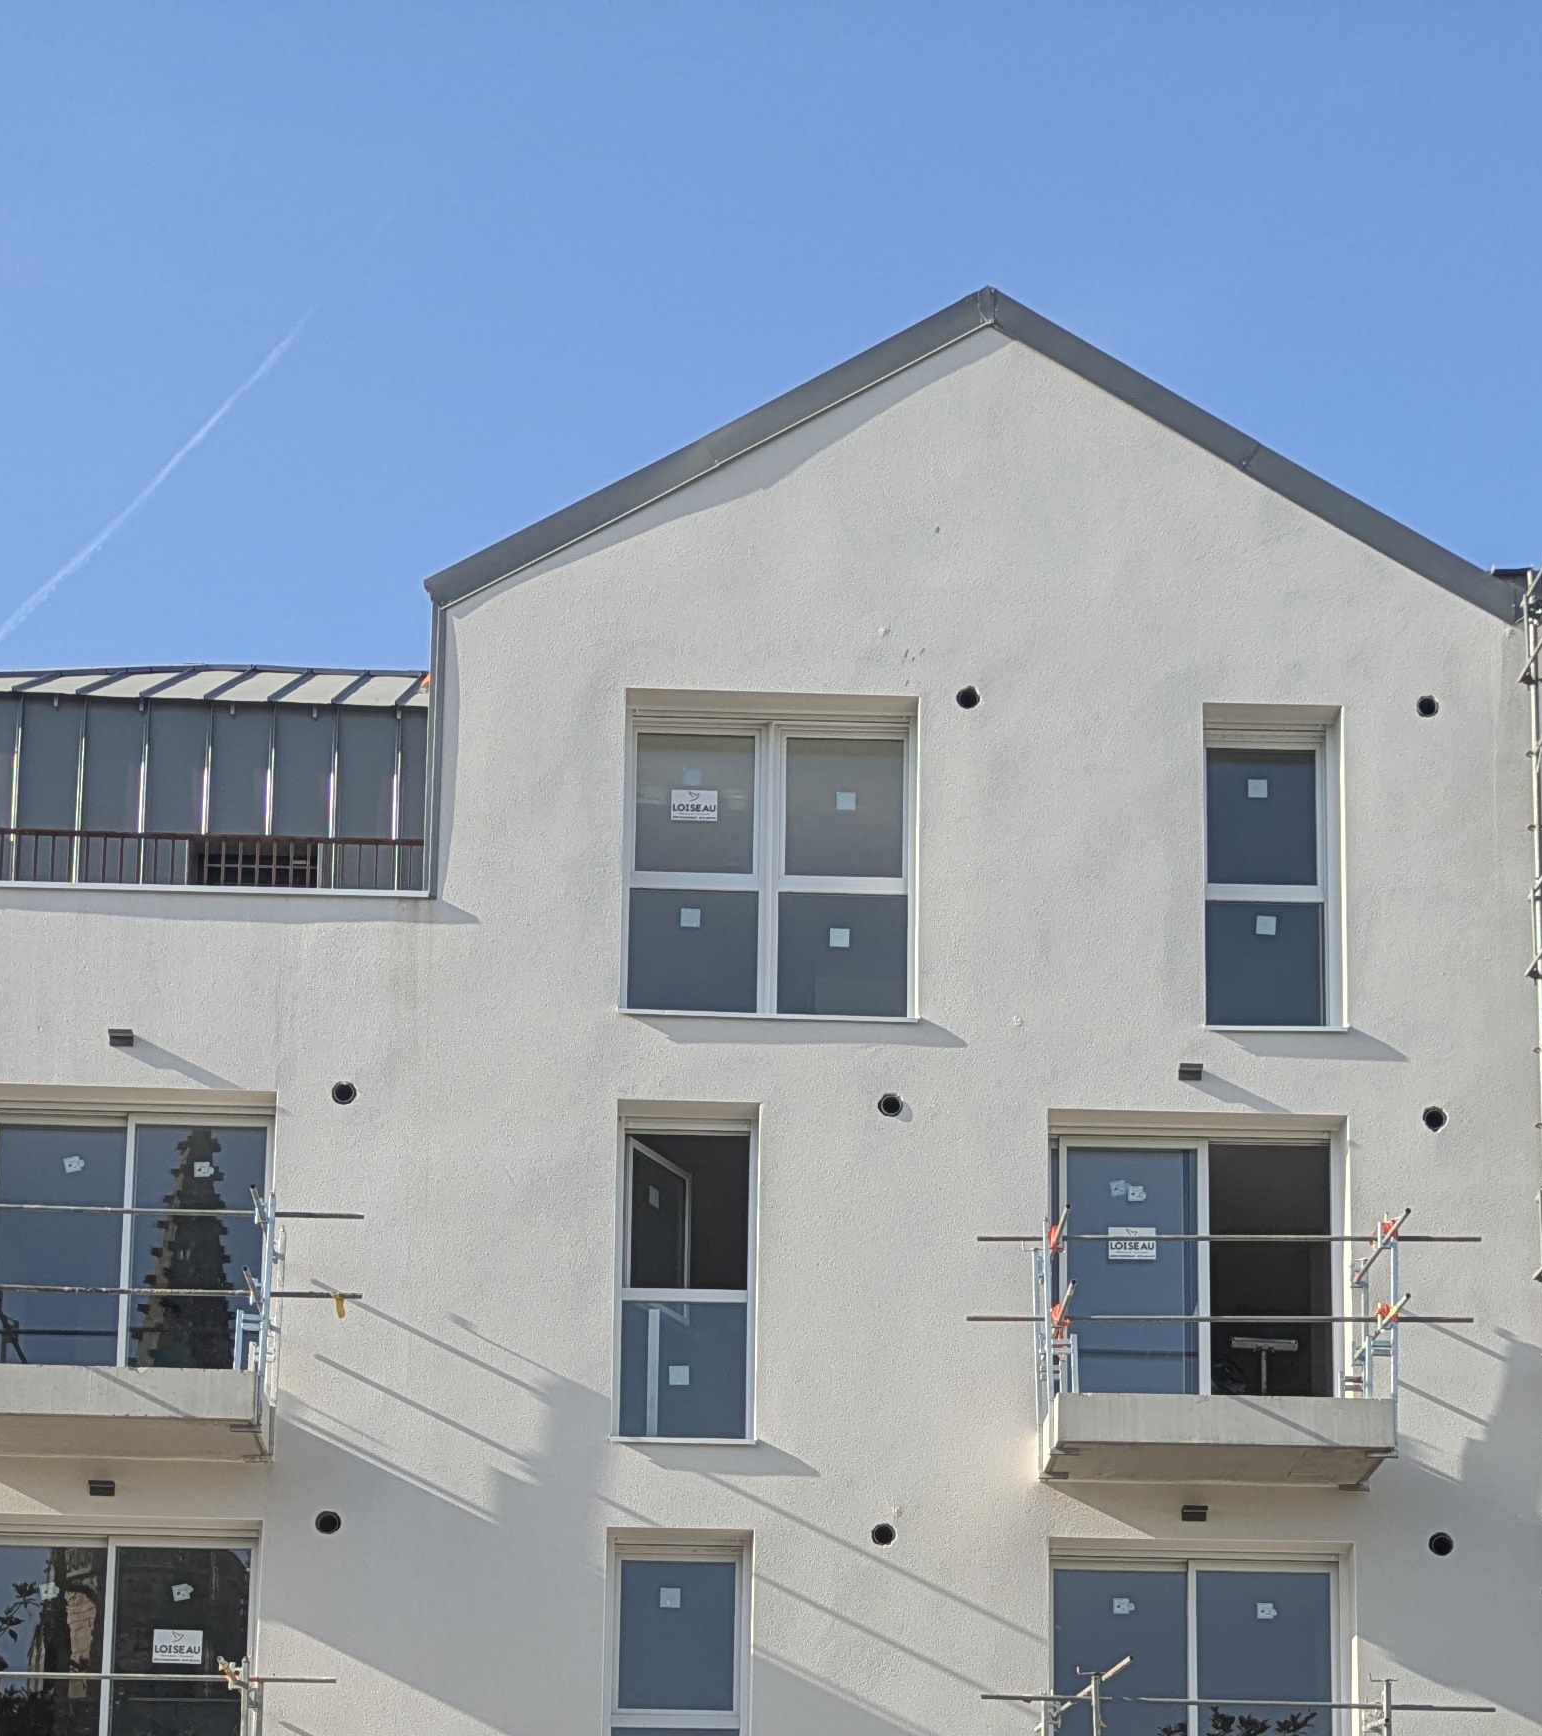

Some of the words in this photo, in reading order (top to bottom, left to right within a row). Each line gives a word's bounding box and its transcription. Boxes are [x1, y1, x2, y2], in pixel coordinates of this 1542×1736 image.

[672, 803, 717, 812] LOISEAU
[1110, 1241, 1155, 1251] LOISEAU
[154, 1644, 201, 1655] LOISEAU
